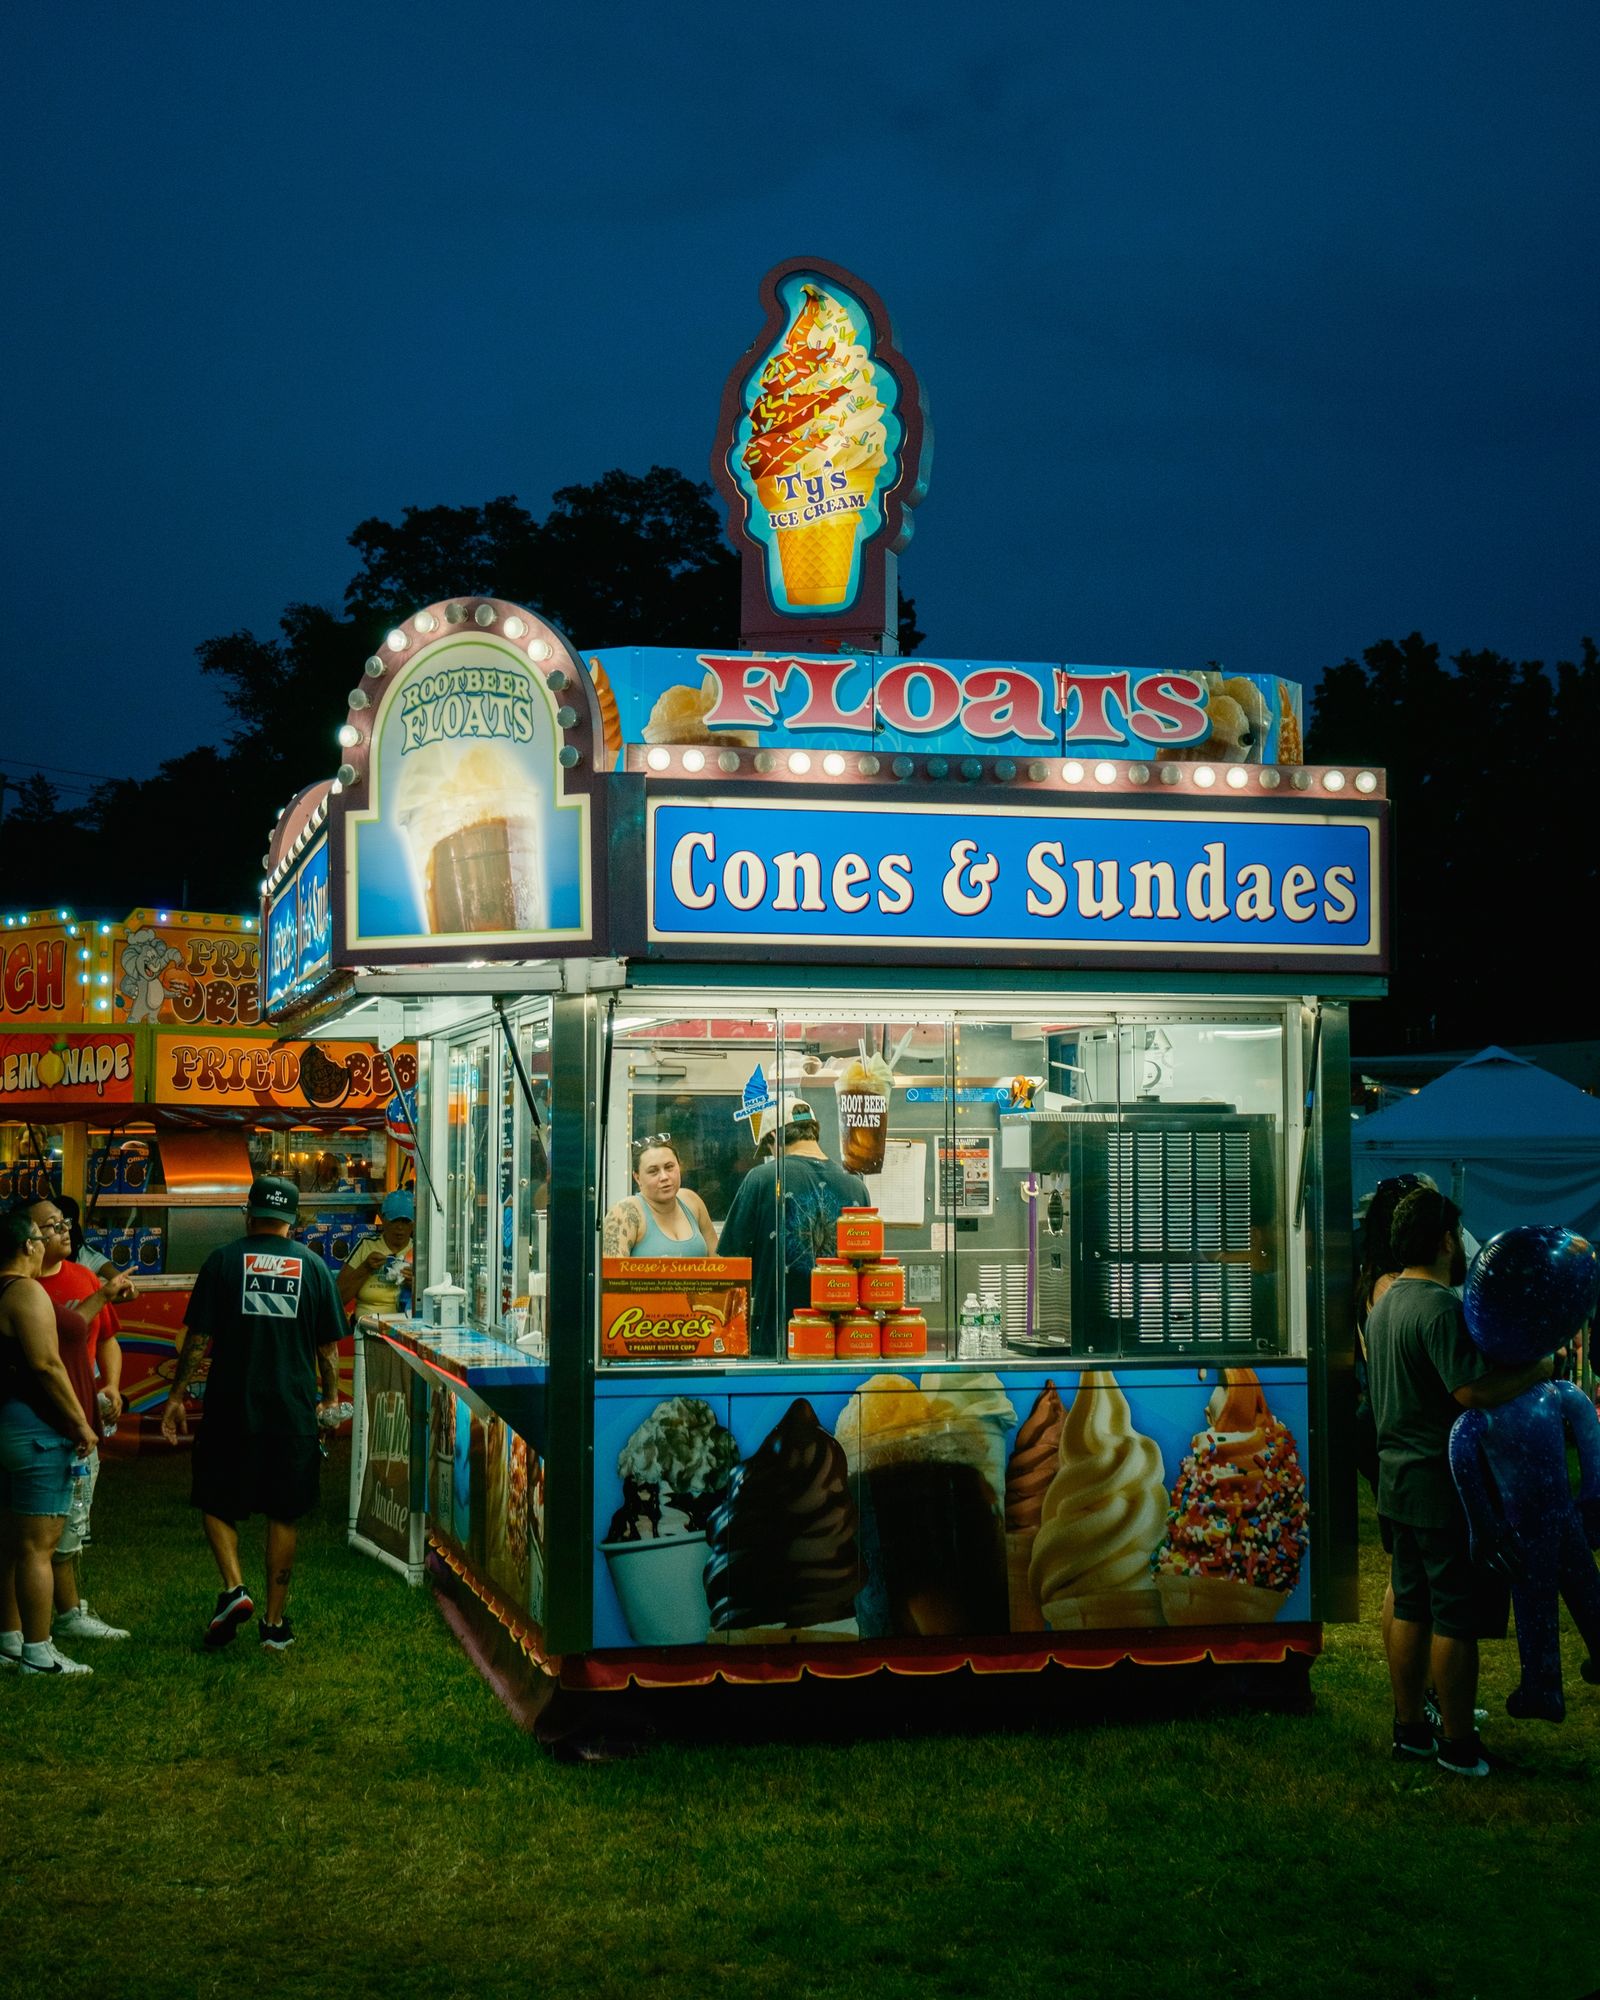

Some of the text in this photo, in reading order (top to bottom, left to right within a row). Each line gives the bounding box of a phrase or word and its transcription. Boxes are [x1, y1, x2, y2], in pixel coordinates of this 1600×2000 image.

[776, 460, 848, 503] Ty's
[769, 494, 866, 528] ICE CREAM
[401, 693, 534, 756] FLOATS
[670, 831, 1358, 924] Cones & Sundaes
[0, 938, 66, 1013] GH
[186, 938, 259, 981] FRI
[171, 978, 260, 1025] ORE
[171, 1045, 300, 1093] FRIED
[841, 1095, 887, 1114] ROOT BEER
[846, 1115, 881, 1128] FLOATS
[253, 1255, 287, 1270] NIKE
[620, 1260, 728, 1273] Reese's Sundae
[250, 1277, 295, 1293] AIR
[608, 1306, 714, 1340] Reese's
